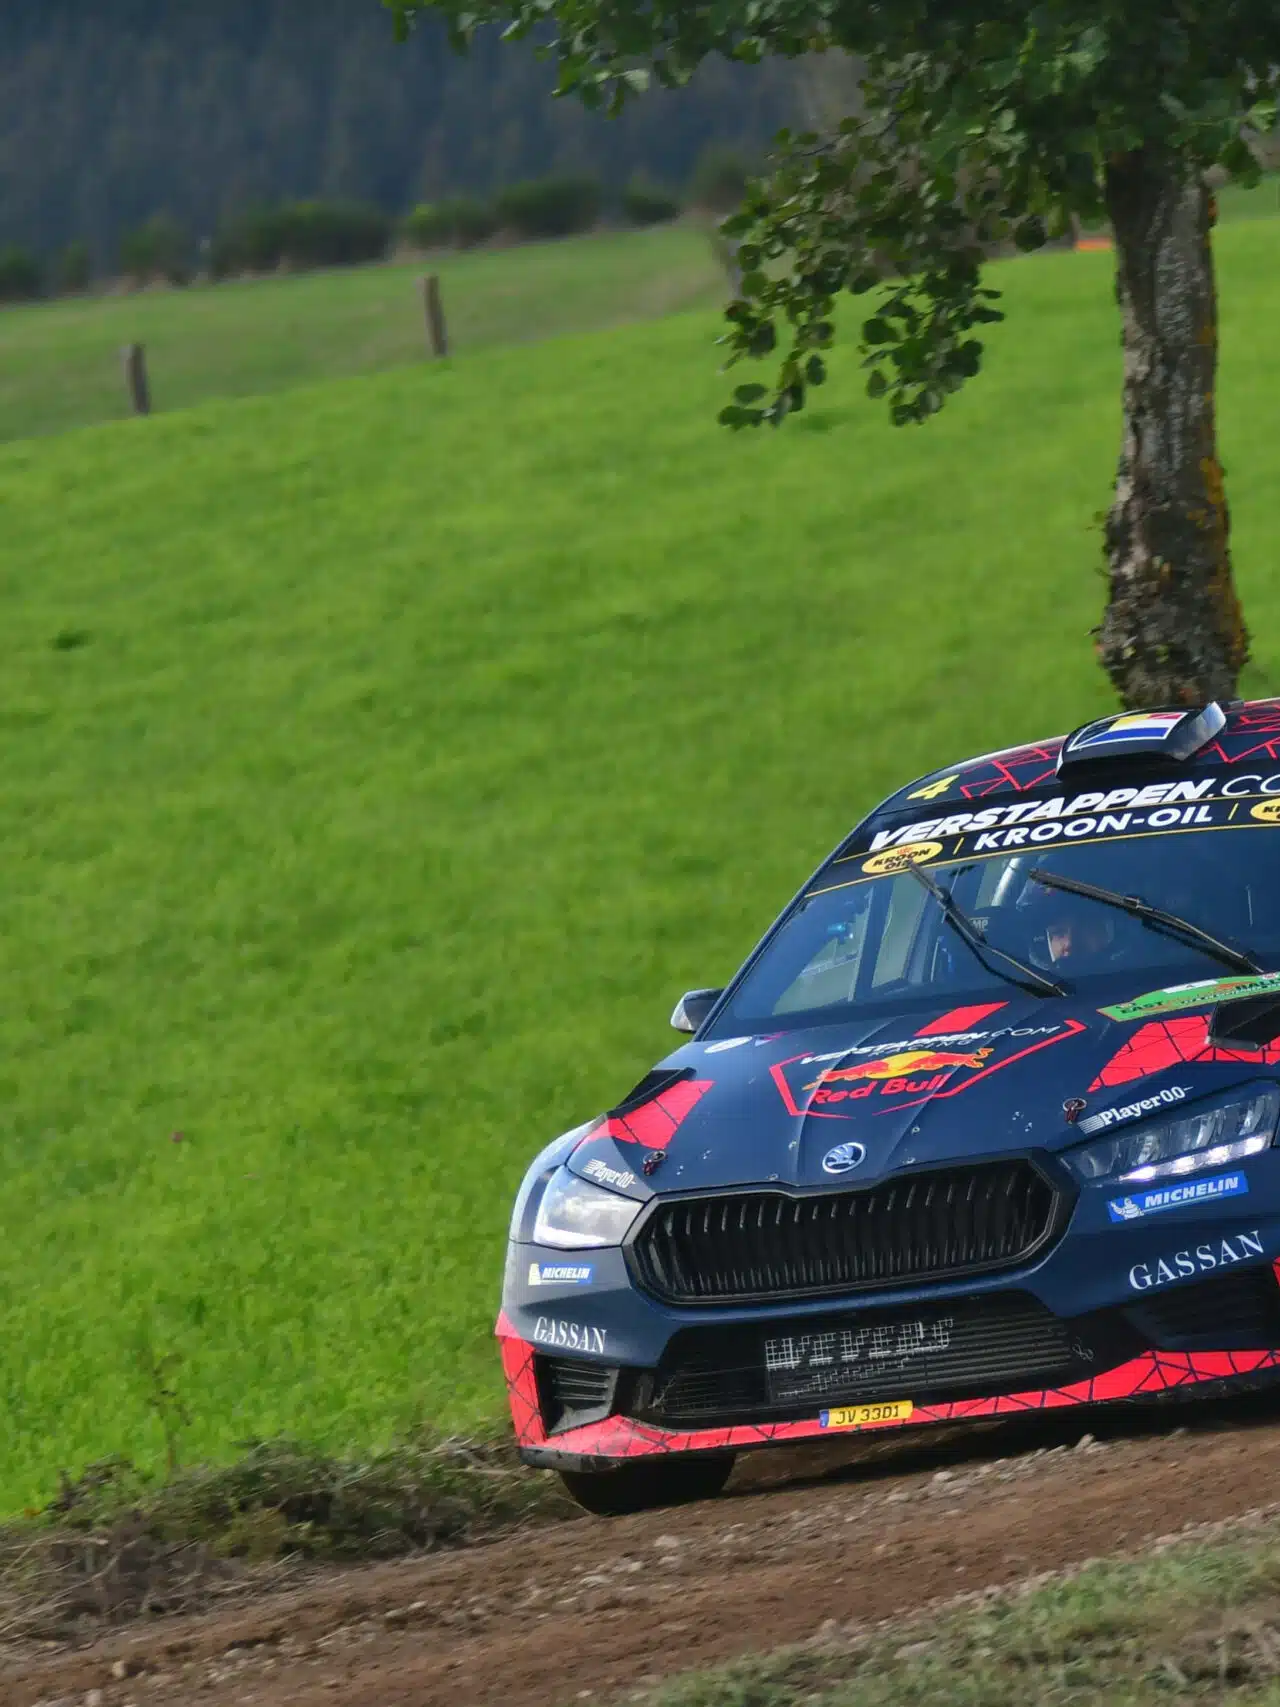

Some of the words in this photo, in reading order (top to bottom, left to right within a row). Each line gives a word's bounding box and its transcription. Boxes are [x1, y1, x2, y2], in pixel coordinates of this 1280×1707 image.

[906, 774, 960, 801] 4
[974, 804, 1213, 851] KROON-OIL
[872, 847, 931, 868] KROON
[811, 1080, 878, 1104] Red
[880, 1072, 953, 1096] Bull
[1144, 1176, 1239, 1208] MICHELIN
[541, 1267, 592, 1280] MICHELIN
[1129, 1230, 1265, 1290] GASSAN
[533, 1316, 607, 1354] GASSAN
[836, 1410, 857, 1425] JV
